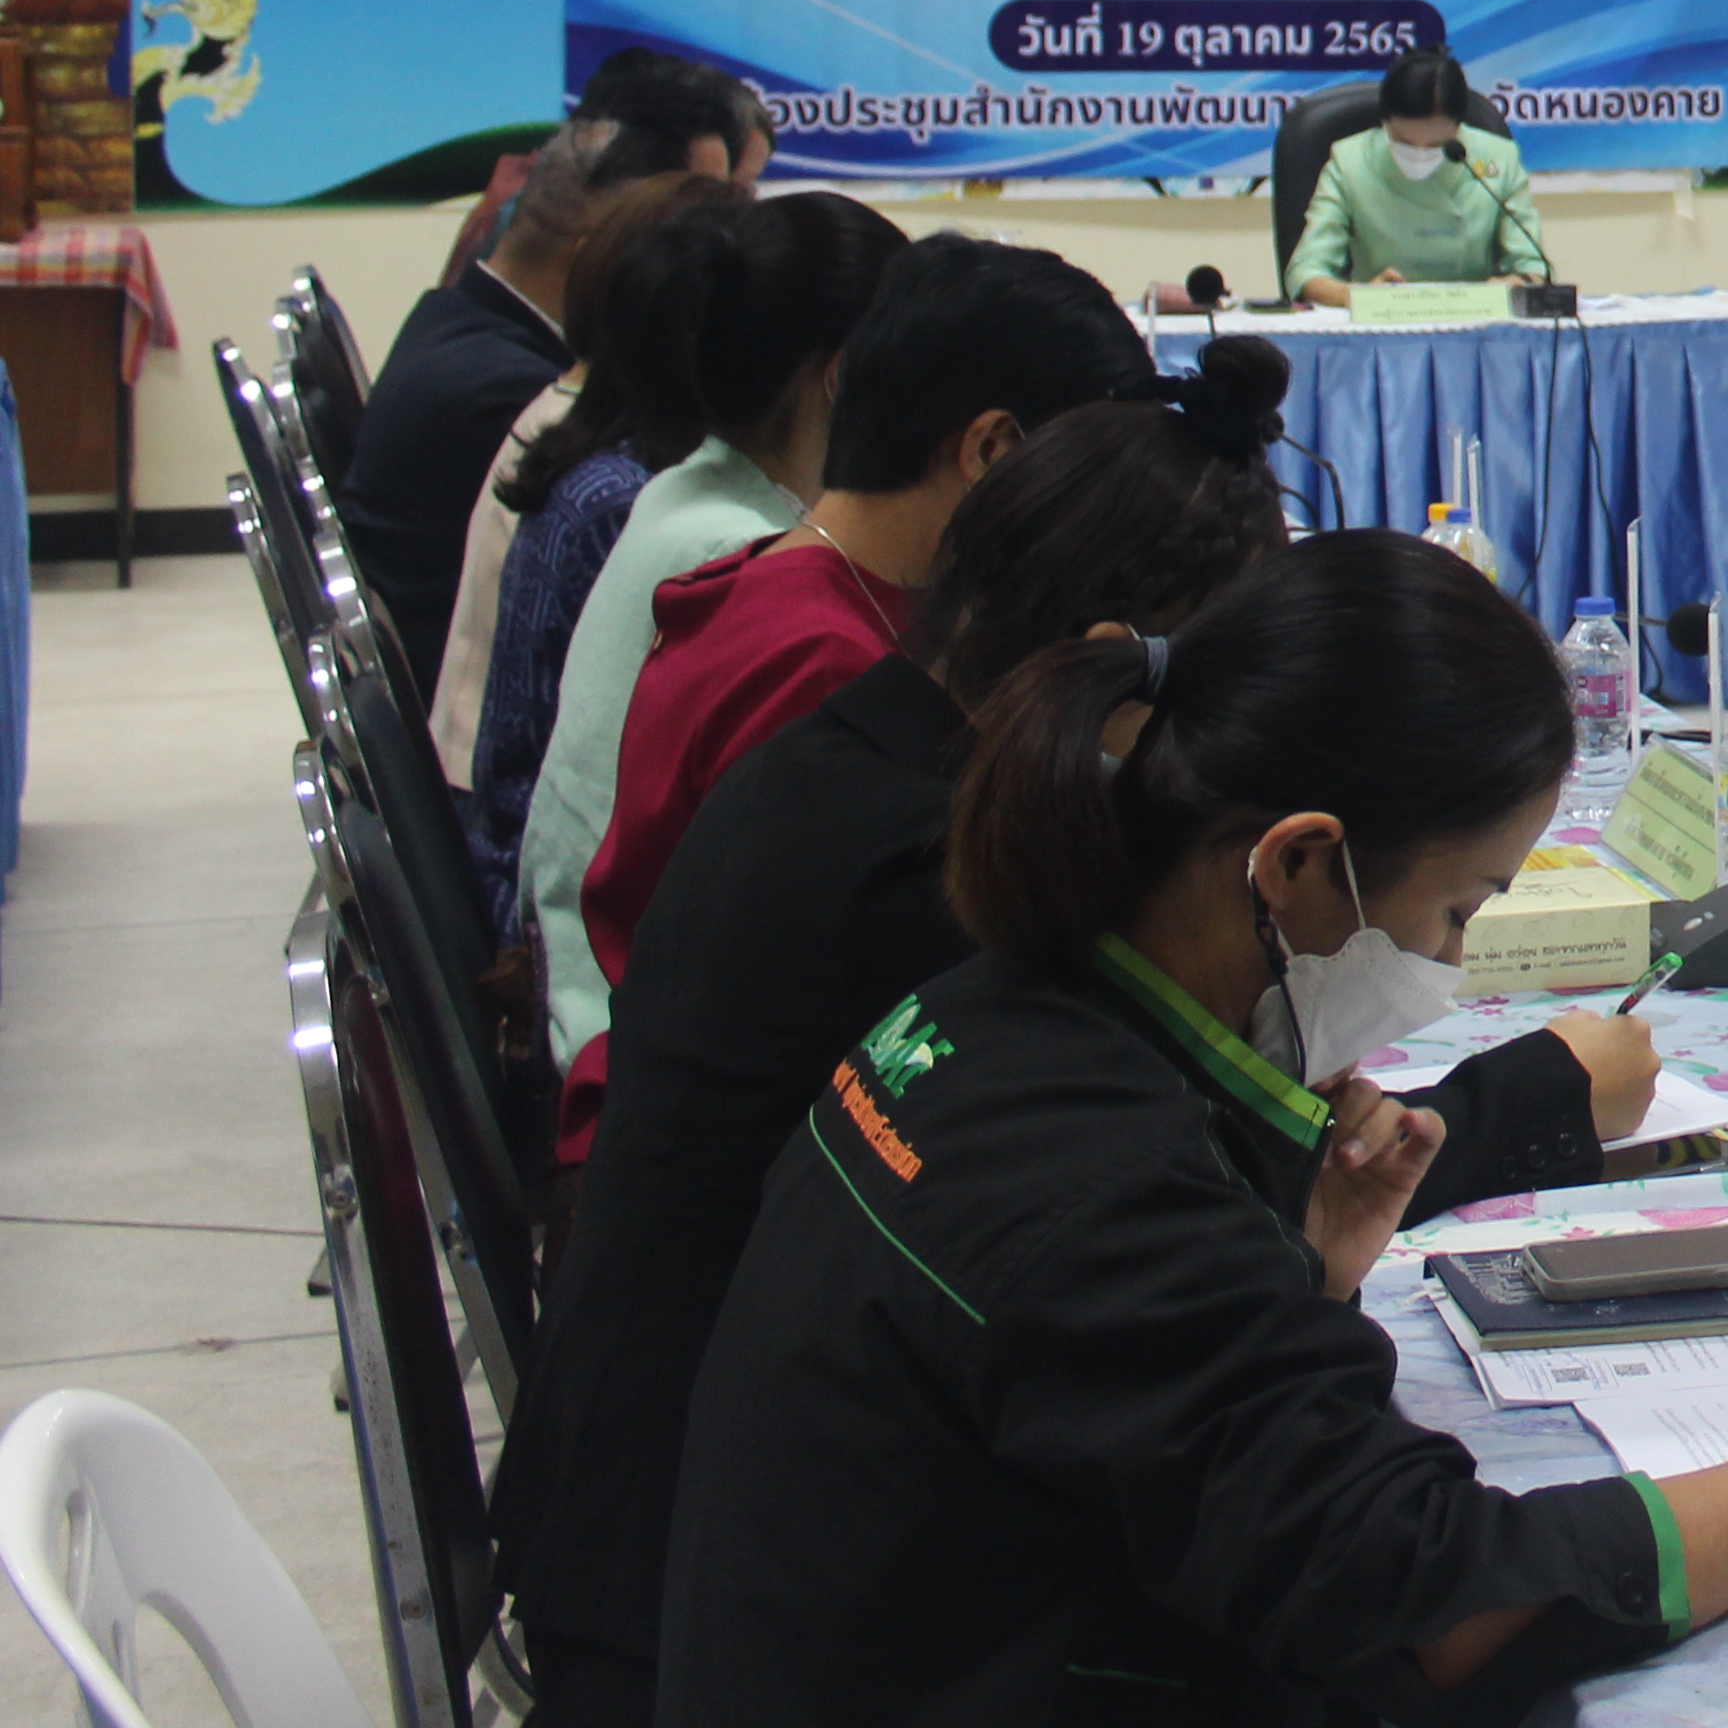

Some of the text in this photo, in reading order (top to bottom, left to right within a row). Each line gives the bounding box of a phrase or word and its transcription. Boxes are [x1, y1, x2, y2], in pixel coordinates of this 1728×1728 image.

[1018, 4, 1416, 67] วันที่ 19 ตุลาคม 2565
